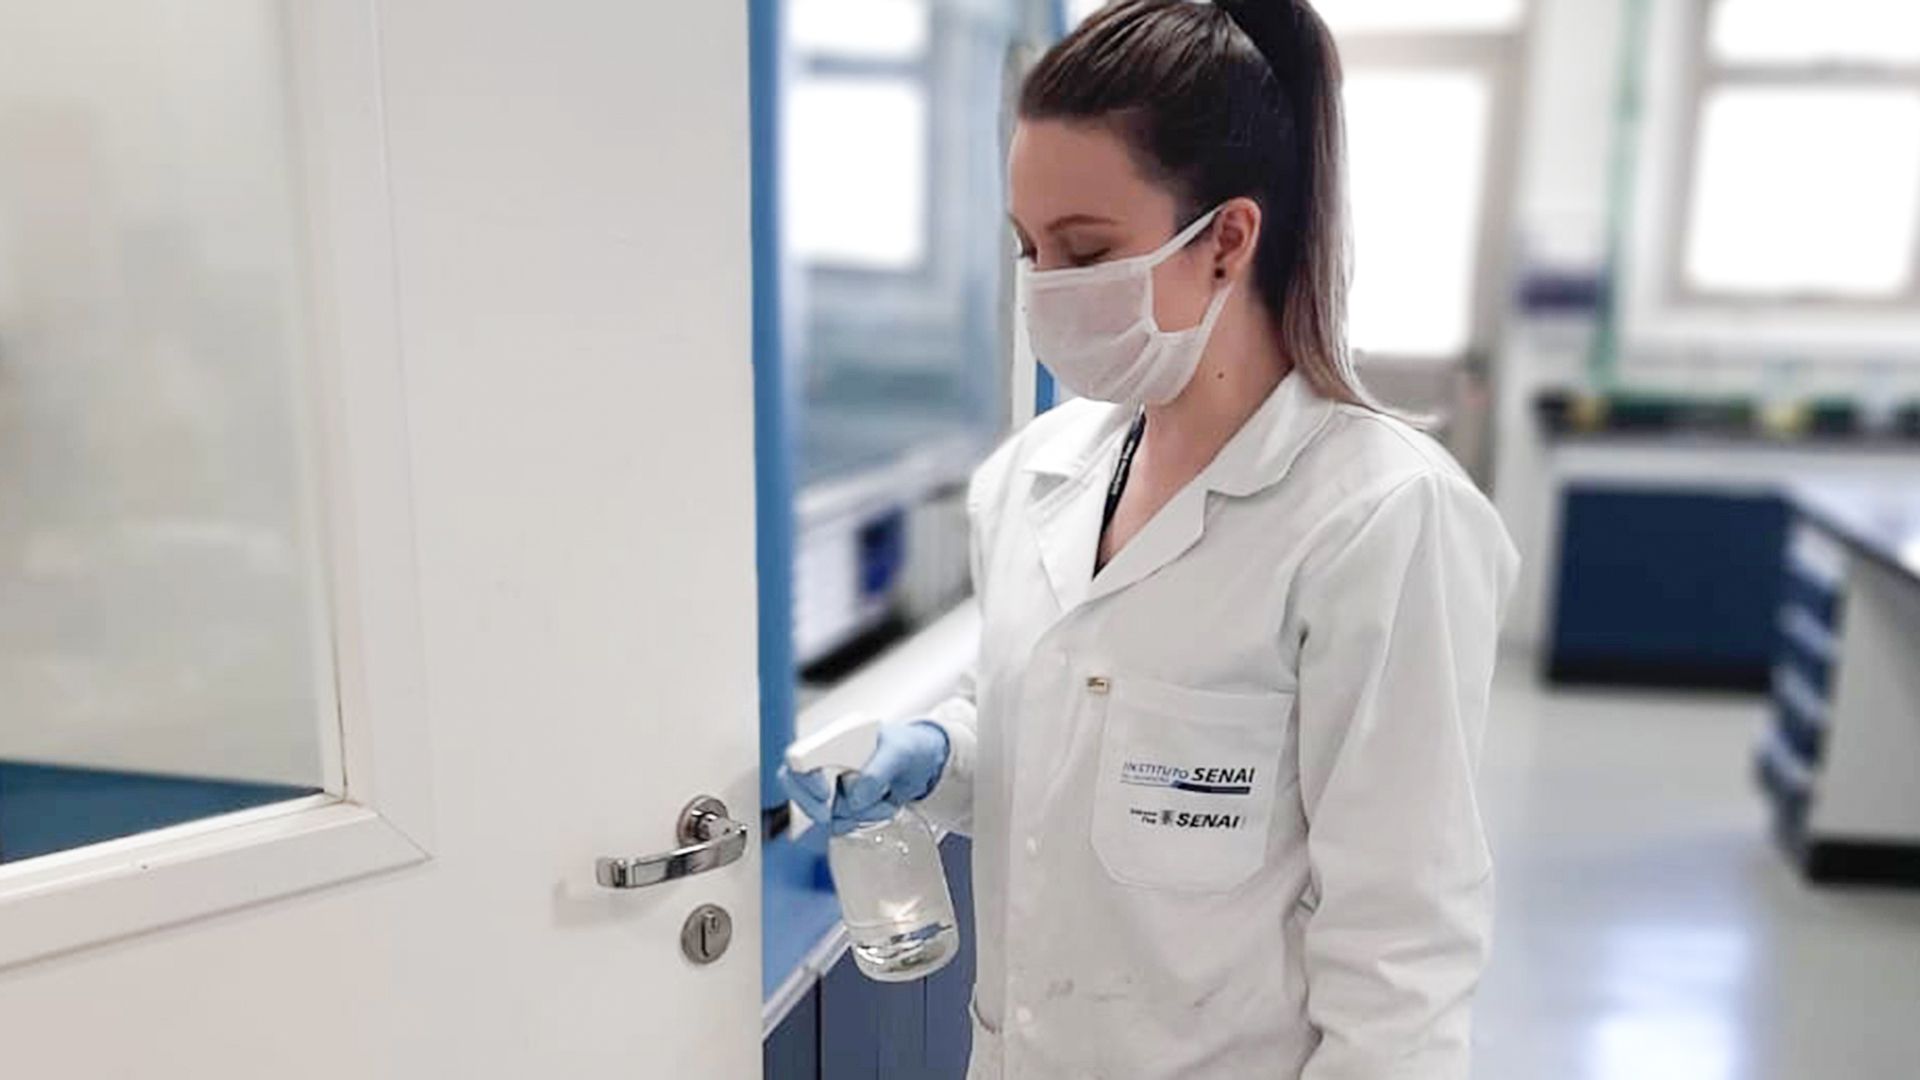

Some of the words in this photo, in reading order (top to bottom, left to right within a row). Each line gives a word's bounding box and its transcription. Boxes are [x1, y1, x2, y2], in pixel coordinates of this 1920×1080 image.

[1123, 761, 1189, 779] INSTITUTO
[1191, 767, 1255, 783] SENAI
[1176, 812, 1240, 828] SENAI
